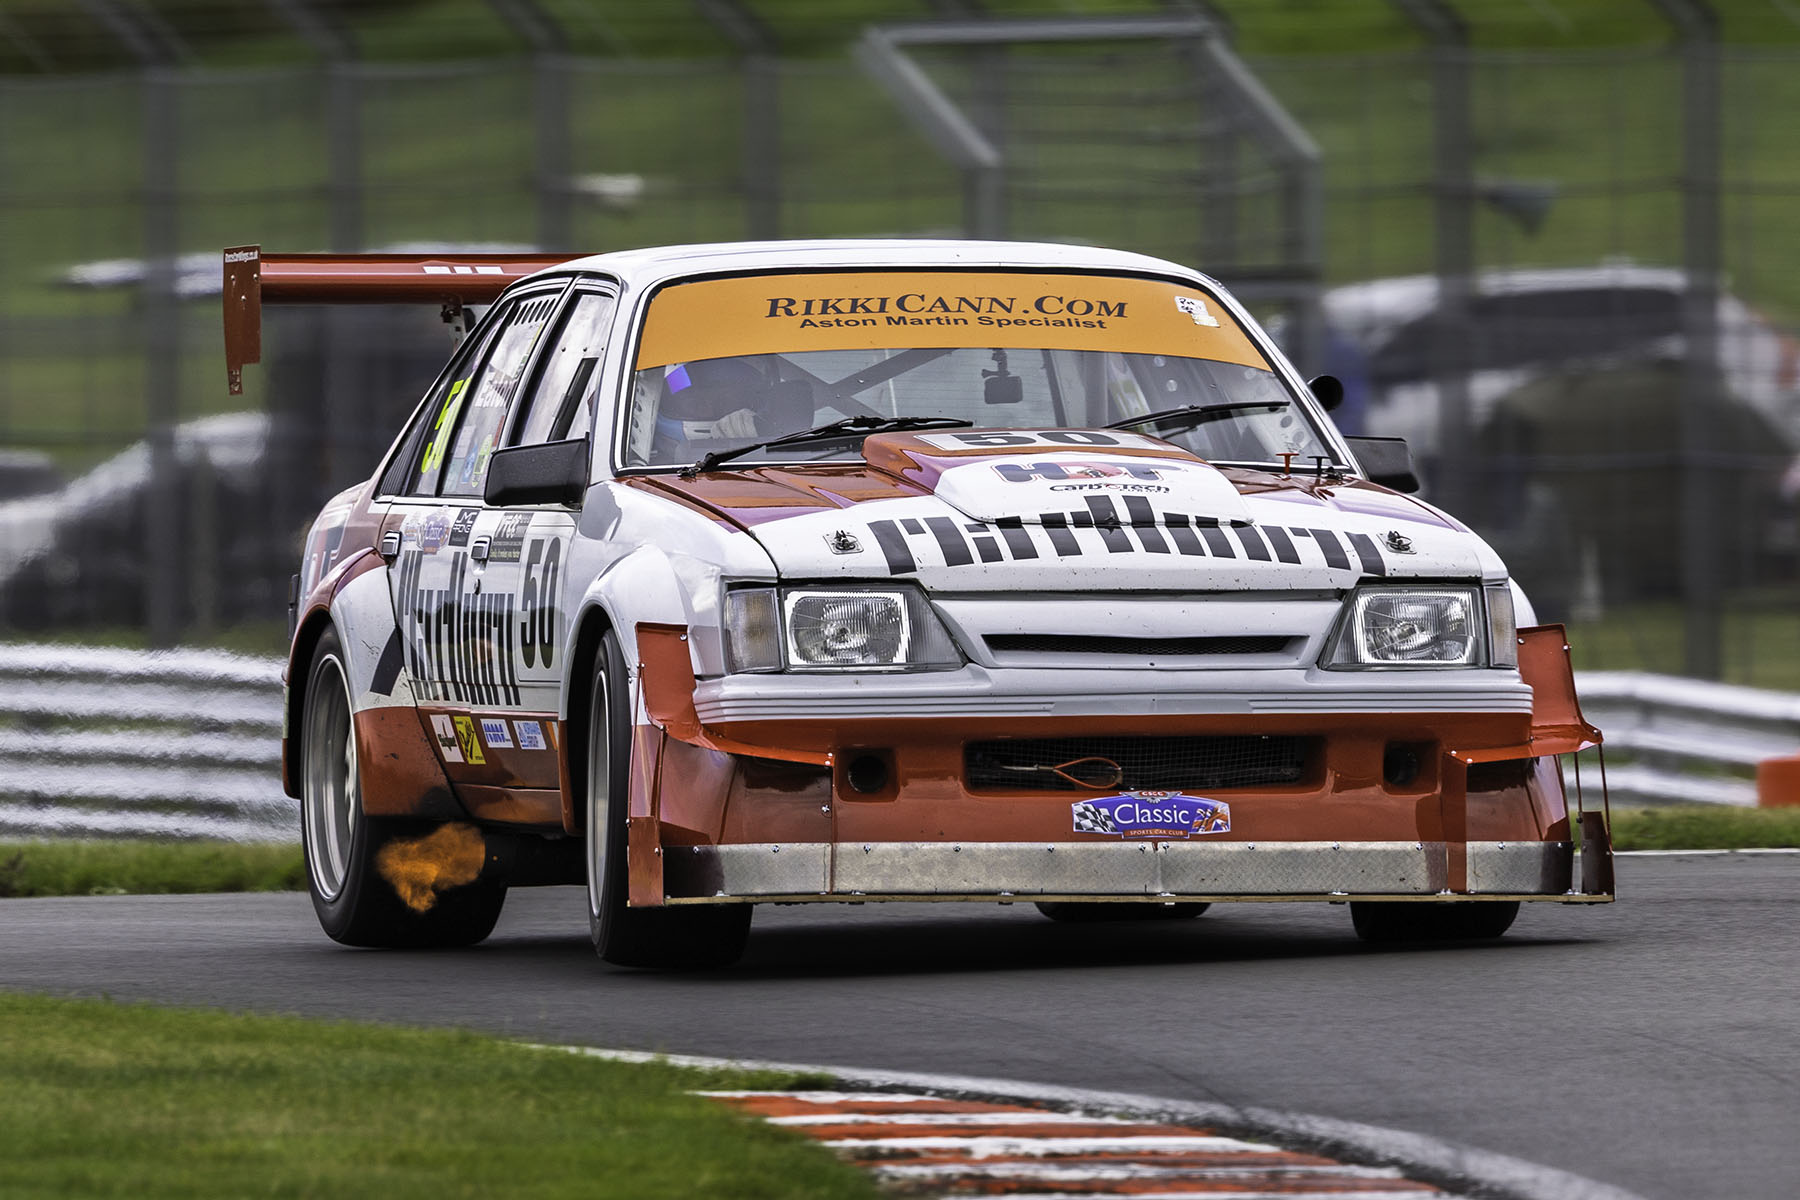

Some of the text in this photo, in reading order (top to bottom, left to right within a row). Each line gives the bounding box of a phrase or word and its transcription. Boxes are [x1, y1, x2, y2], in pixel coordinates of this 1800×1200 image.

[799, 315, 1107, 329] Aston Martin Specialist
[951, 432, 1121, 446] 50
[520, 537, 561, 669] 50
[1113, 803, 1190, 824] Classic
